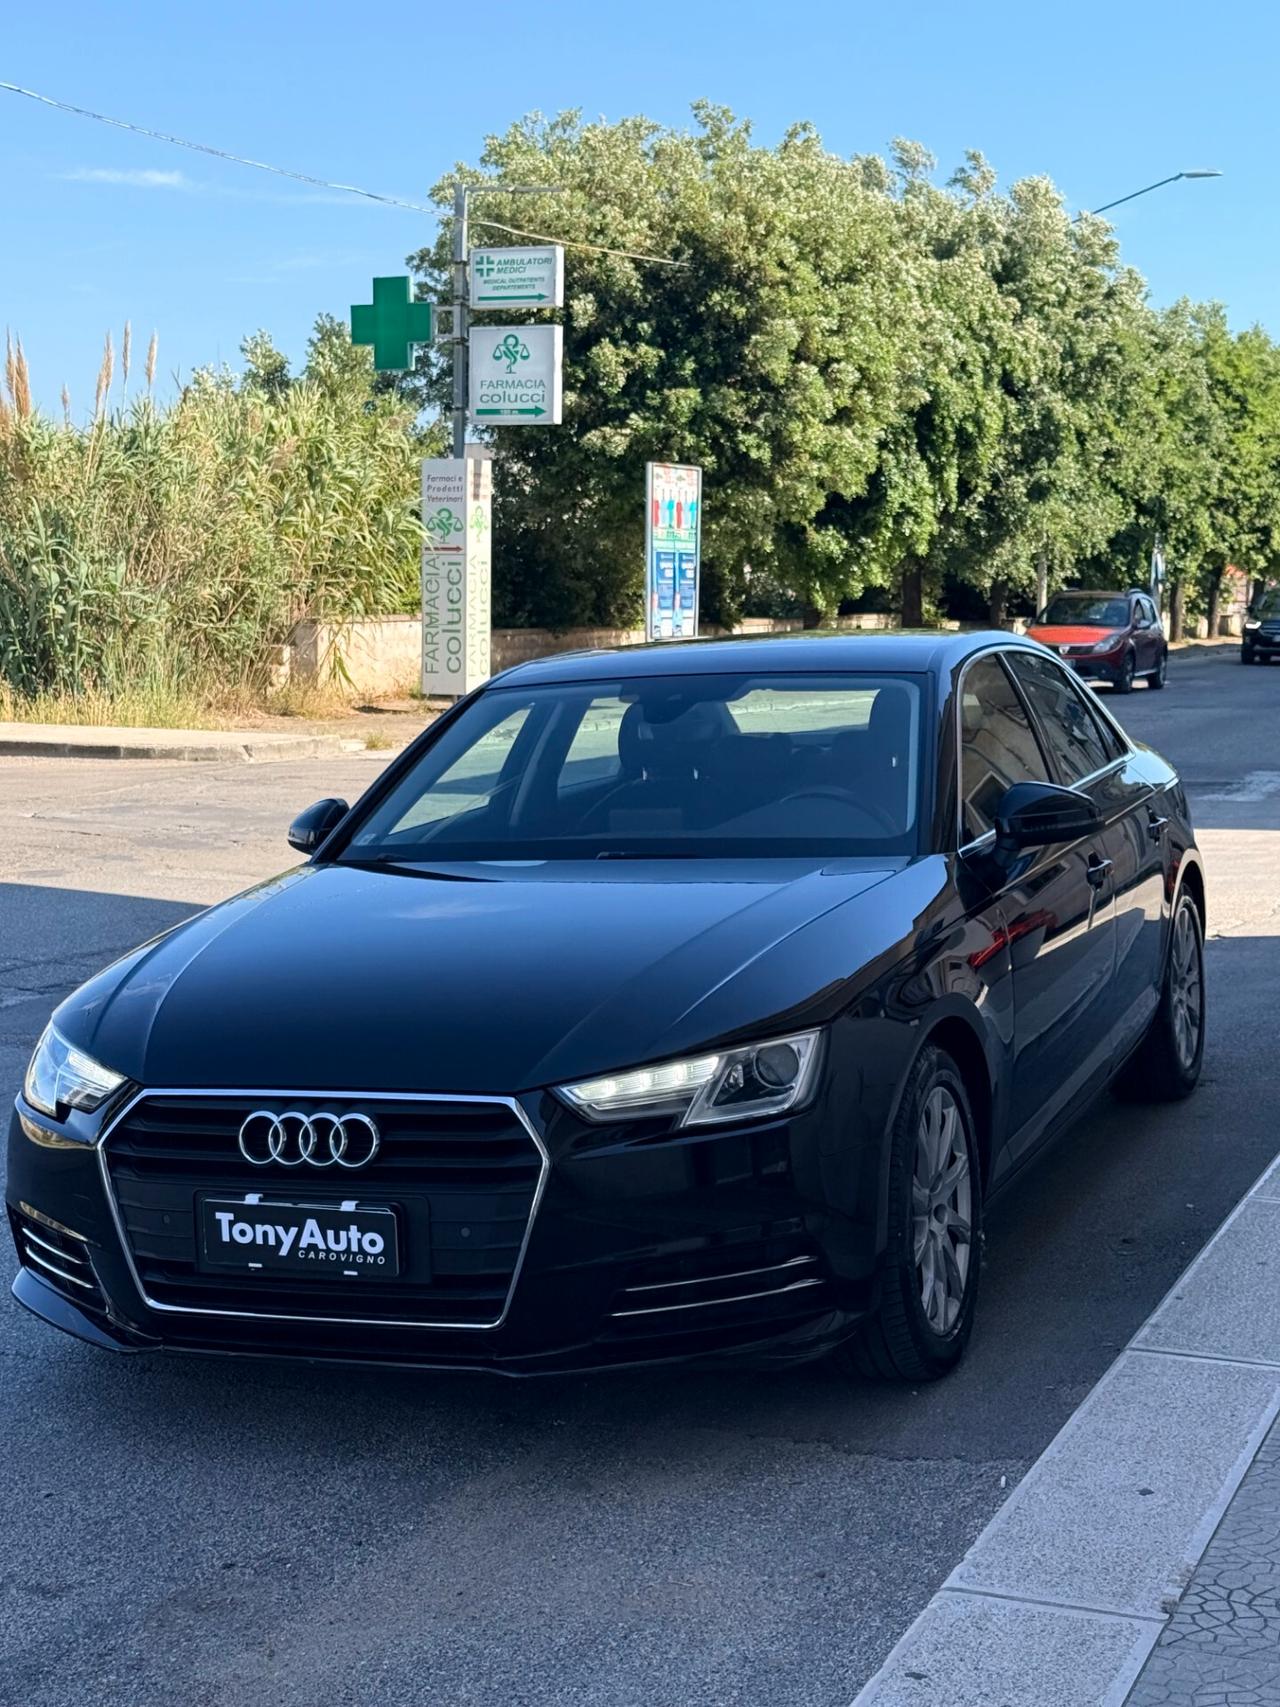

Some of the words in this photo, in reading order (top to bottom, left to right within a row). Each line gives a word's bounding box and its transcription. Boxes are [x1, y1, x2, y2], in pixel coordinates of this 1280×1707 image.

[497, 257, 553, 266] AMBULATORI
[496, 266, 527, 274] MEDICI
[480, 379, 546, 389] FARMACIA
[480, 390, 545, 403] colucci
[427, 474, 456, 482] Farmaci
[425, 556, 441, 674] FARMACIA
[441, 562, 462, 674] colucci
[215, 1212, 385, 1256] TonyAuto
[298, 1250, 386, 1265] CAROVIGNO
